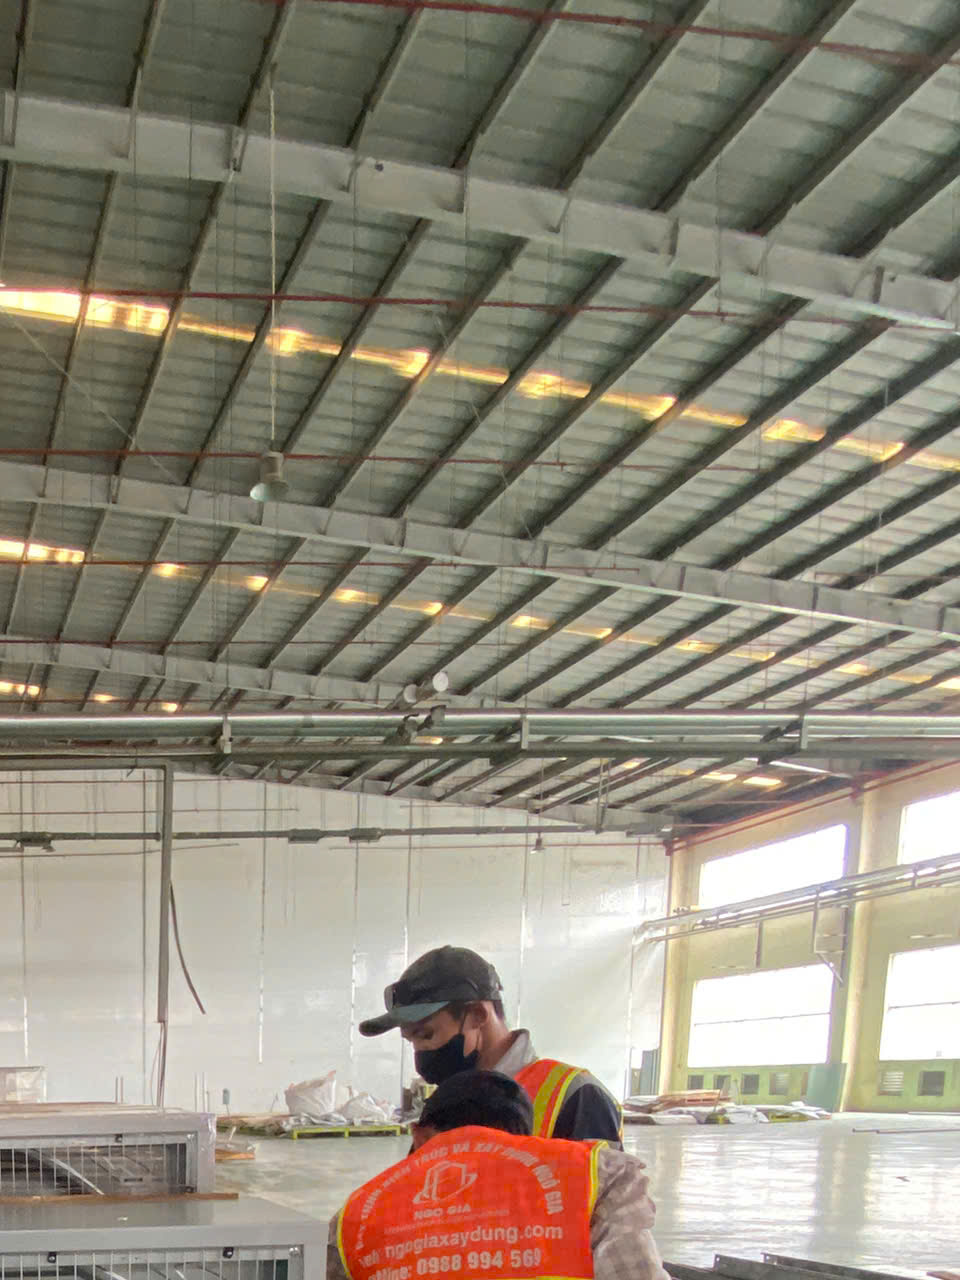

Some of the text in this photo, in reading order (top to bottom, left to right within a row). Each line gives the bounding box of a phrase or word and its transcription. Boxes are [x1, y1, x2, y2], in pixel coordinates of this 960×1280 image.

[385, 1225, 563, 1260] ngogiaxaydung.com
[416, 1254, 463, 1276] 0988
[467, 1250, 504, 1270] 994
